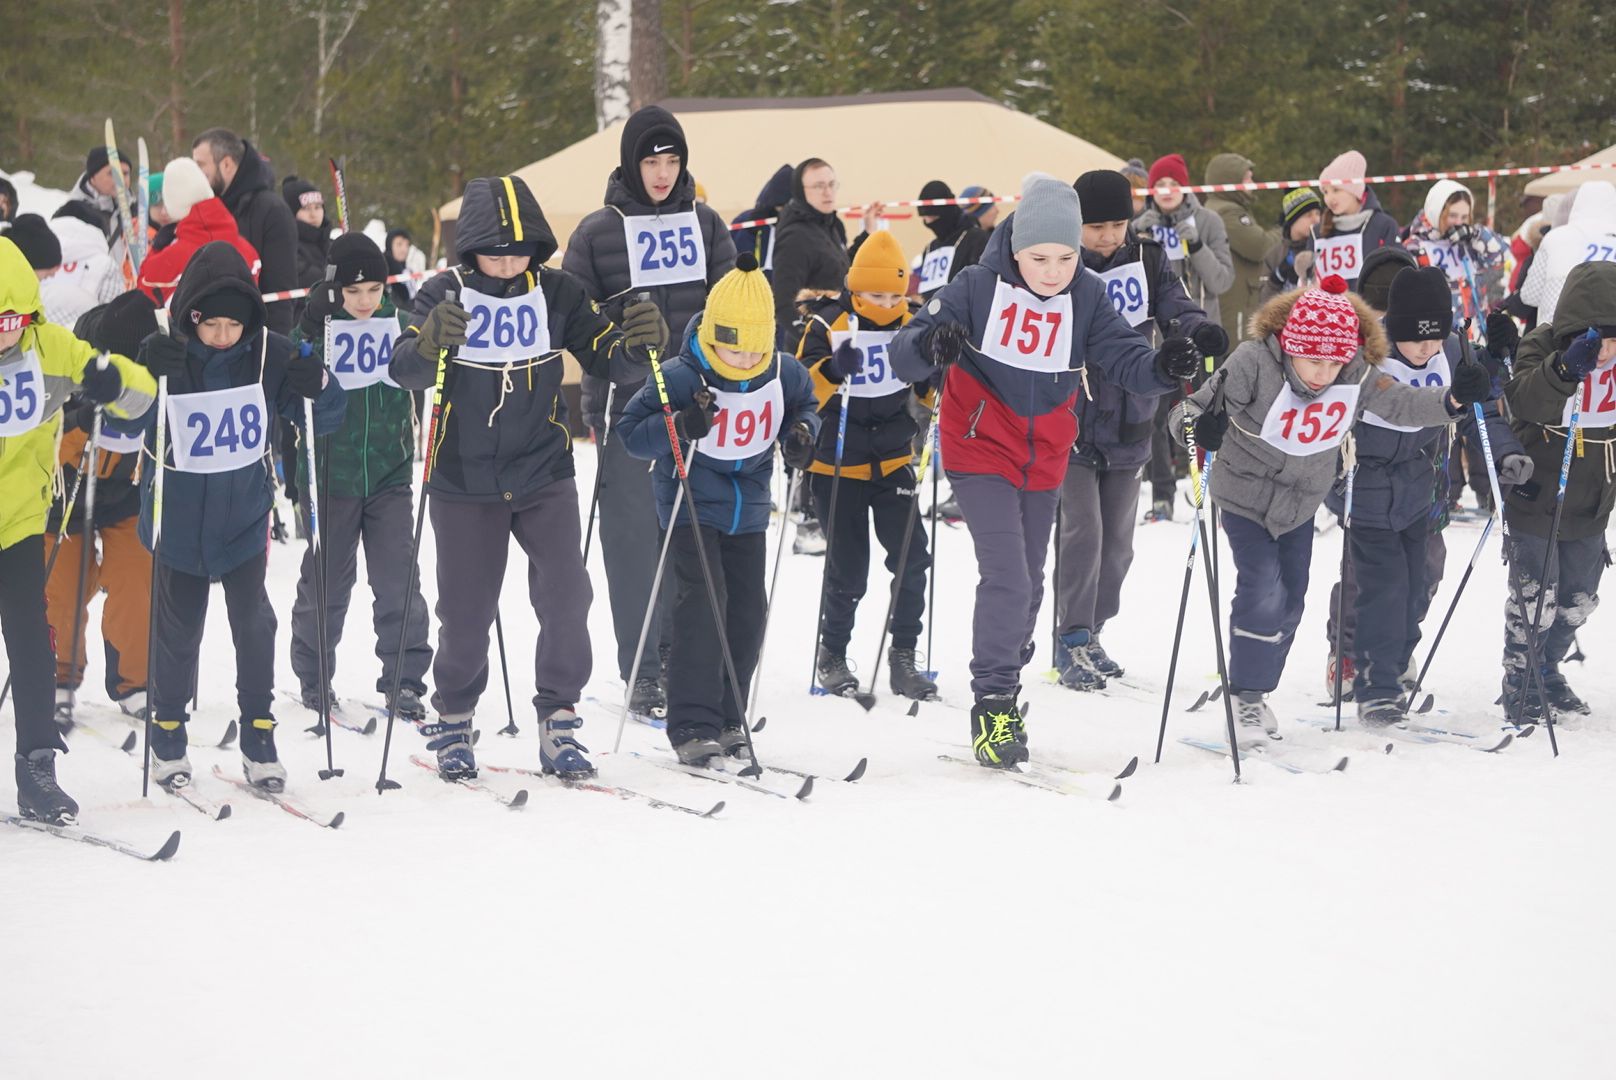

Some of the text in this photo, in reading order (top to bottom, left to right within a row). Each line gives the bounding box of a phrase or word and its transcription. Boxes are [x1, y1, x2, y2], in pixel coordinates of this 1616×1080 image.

[637, 226, 698, 271] 255
[1320, 244, 1356, 273] 153
[1584, 243, 1616, 262] 27
[465, 304, 538, 349] 260
[999, 302, 1062, 357] 157
[334, 332, 393, 374] 264
[1581, 364, 1616, 413] 12
[187, 403, 262, 458] 248
[711, 400, 772, 448] 191
[1279, 401, 1347, 444] 152
[1477, 418, 1495, 468] NORDWAY
